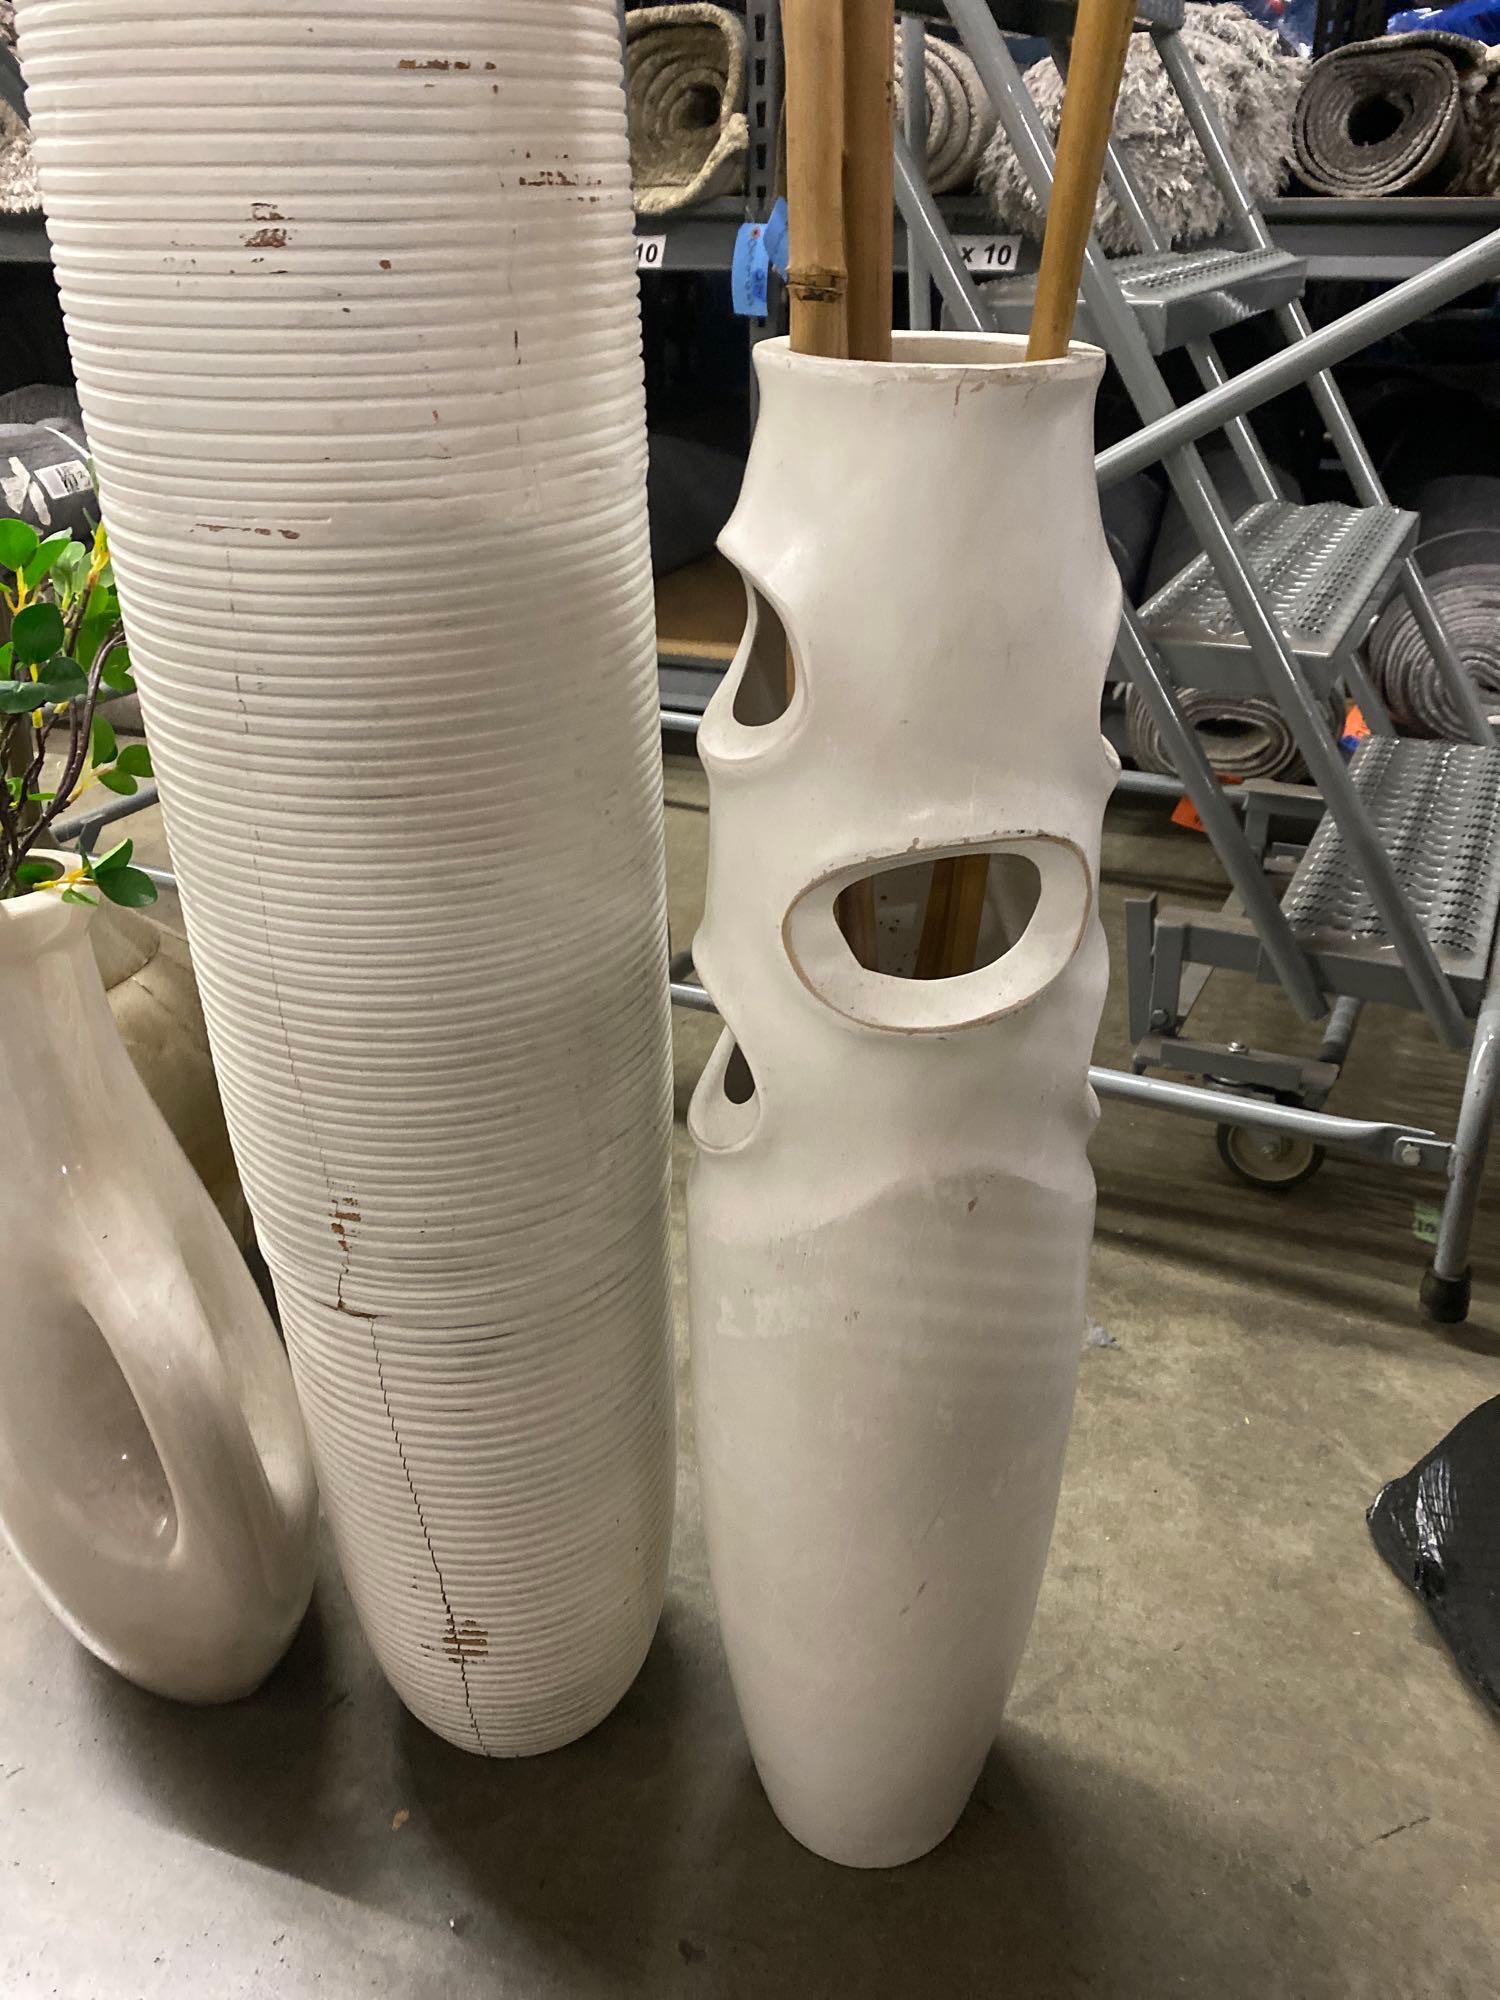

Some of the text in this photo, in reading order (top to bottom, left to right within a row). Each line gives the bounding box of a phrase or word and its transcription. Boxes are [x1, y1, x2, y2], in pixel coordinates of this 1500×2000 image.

[636, 243, 658, 263] 10
[961, 243, 1012, 265] x 10
